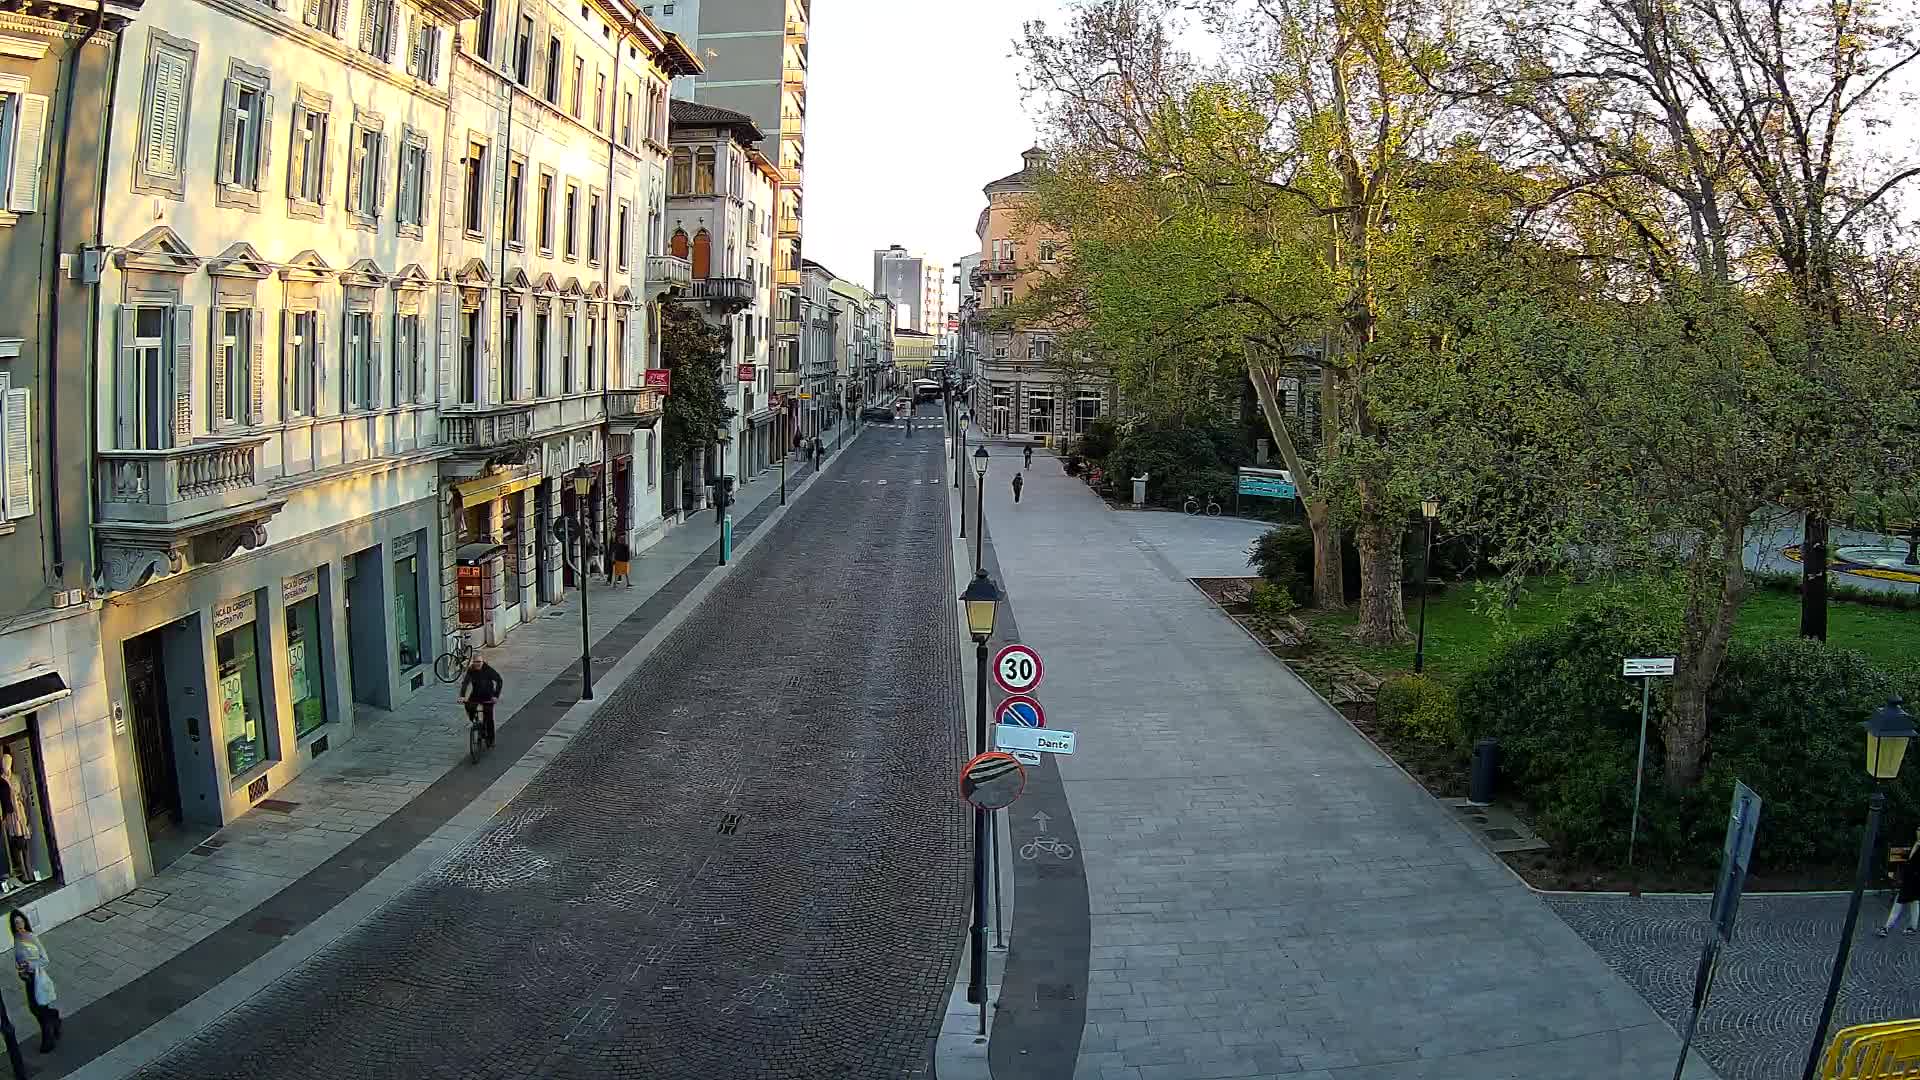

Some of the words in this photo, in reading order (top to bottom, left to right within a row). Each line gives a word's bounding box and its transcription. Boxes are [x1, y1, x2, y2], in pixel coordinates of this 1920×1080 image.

[215, 611, 243, 628] OPERATIVO
[1005, 658, 1032, 680] 30
[1038, 738, 1068, 749] Dante
